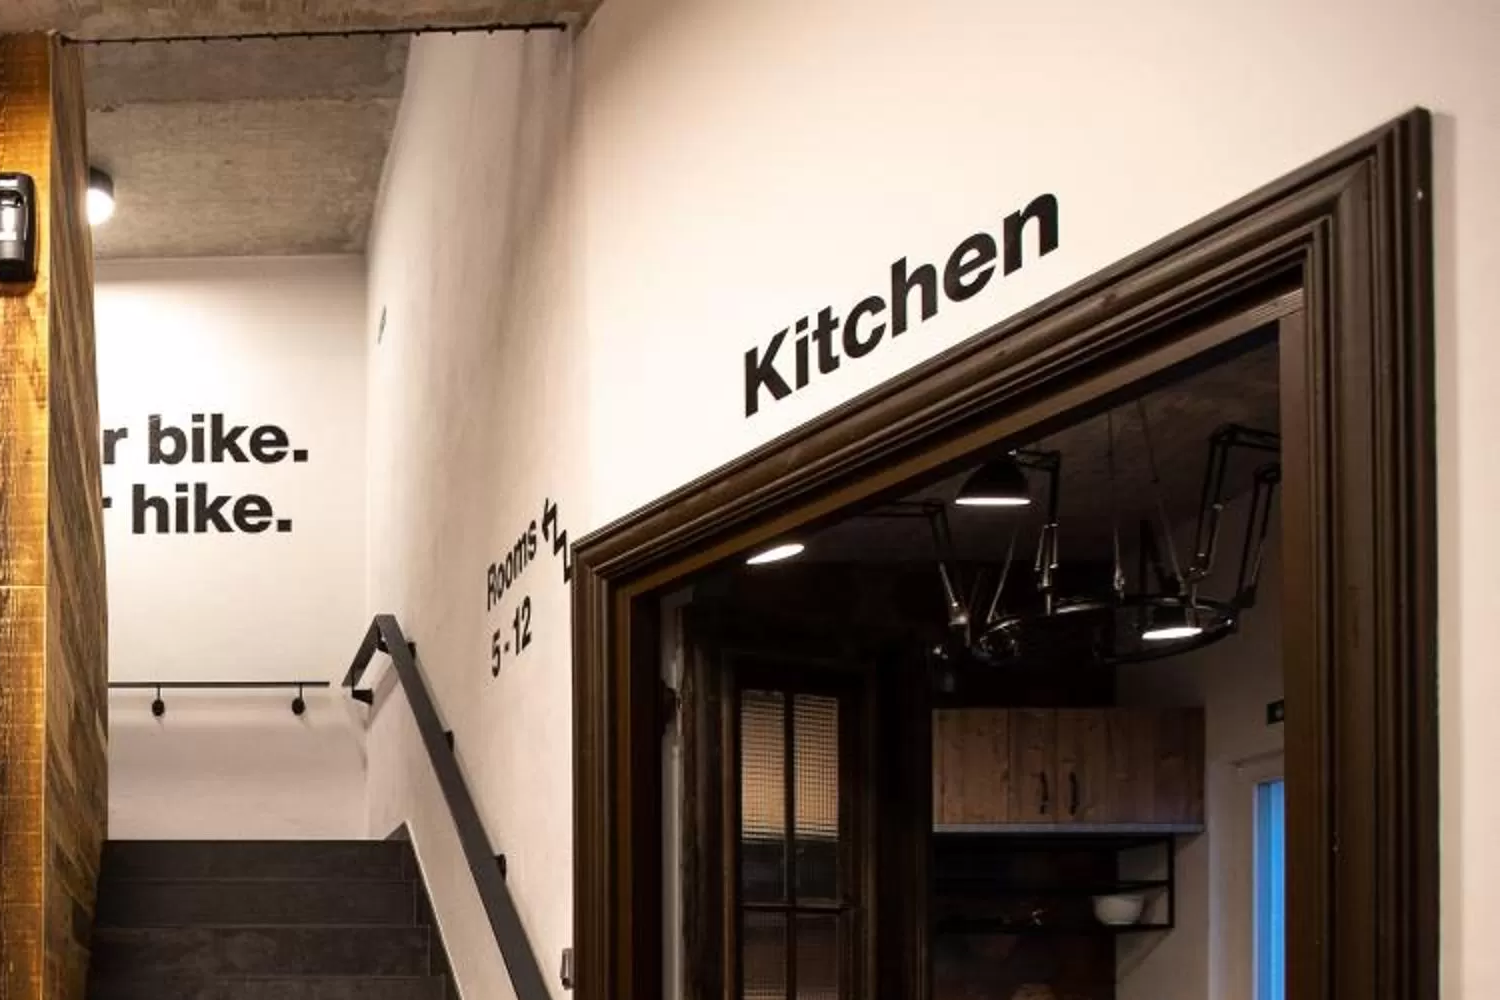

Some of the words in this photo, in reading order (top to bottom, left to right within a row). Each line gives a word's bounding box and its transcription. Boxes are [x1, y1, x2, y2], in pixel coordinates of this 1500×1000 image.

[745, 193, 1059, 419] Kitchen
[148, 413, 308, 465] bike.
[132, 482, 292, 534] hike.
[487, 520, 537, 612] Rooms
